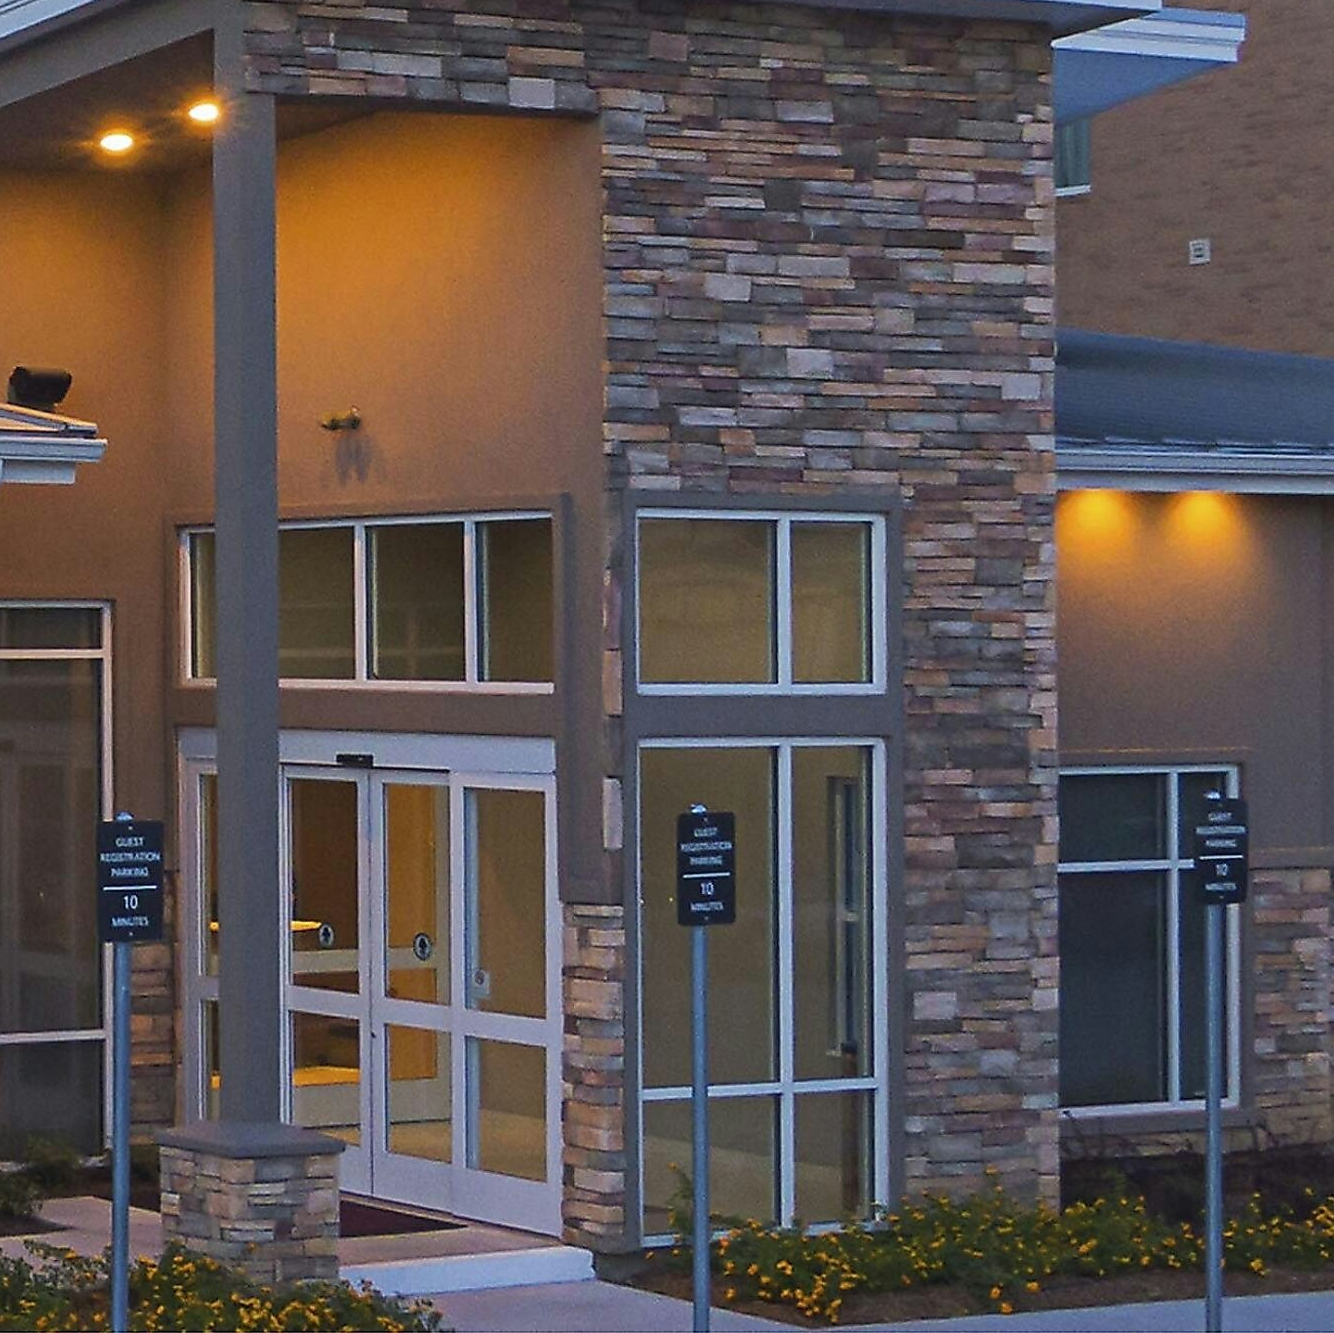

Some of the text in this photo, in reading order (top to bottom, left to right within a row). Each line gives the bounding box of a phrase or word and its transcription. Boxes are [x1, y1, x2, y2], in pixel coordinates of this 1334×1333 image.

[115, 836, 145, 847] GUEST
[99, 852, 161, 863] REGISTRATION
[110, 866, 149, 877] PARKING
[700, 882, 715, 896] 10
[123, 895, 139, 910] 10
[111, 916, 149, 928] MINUTES
